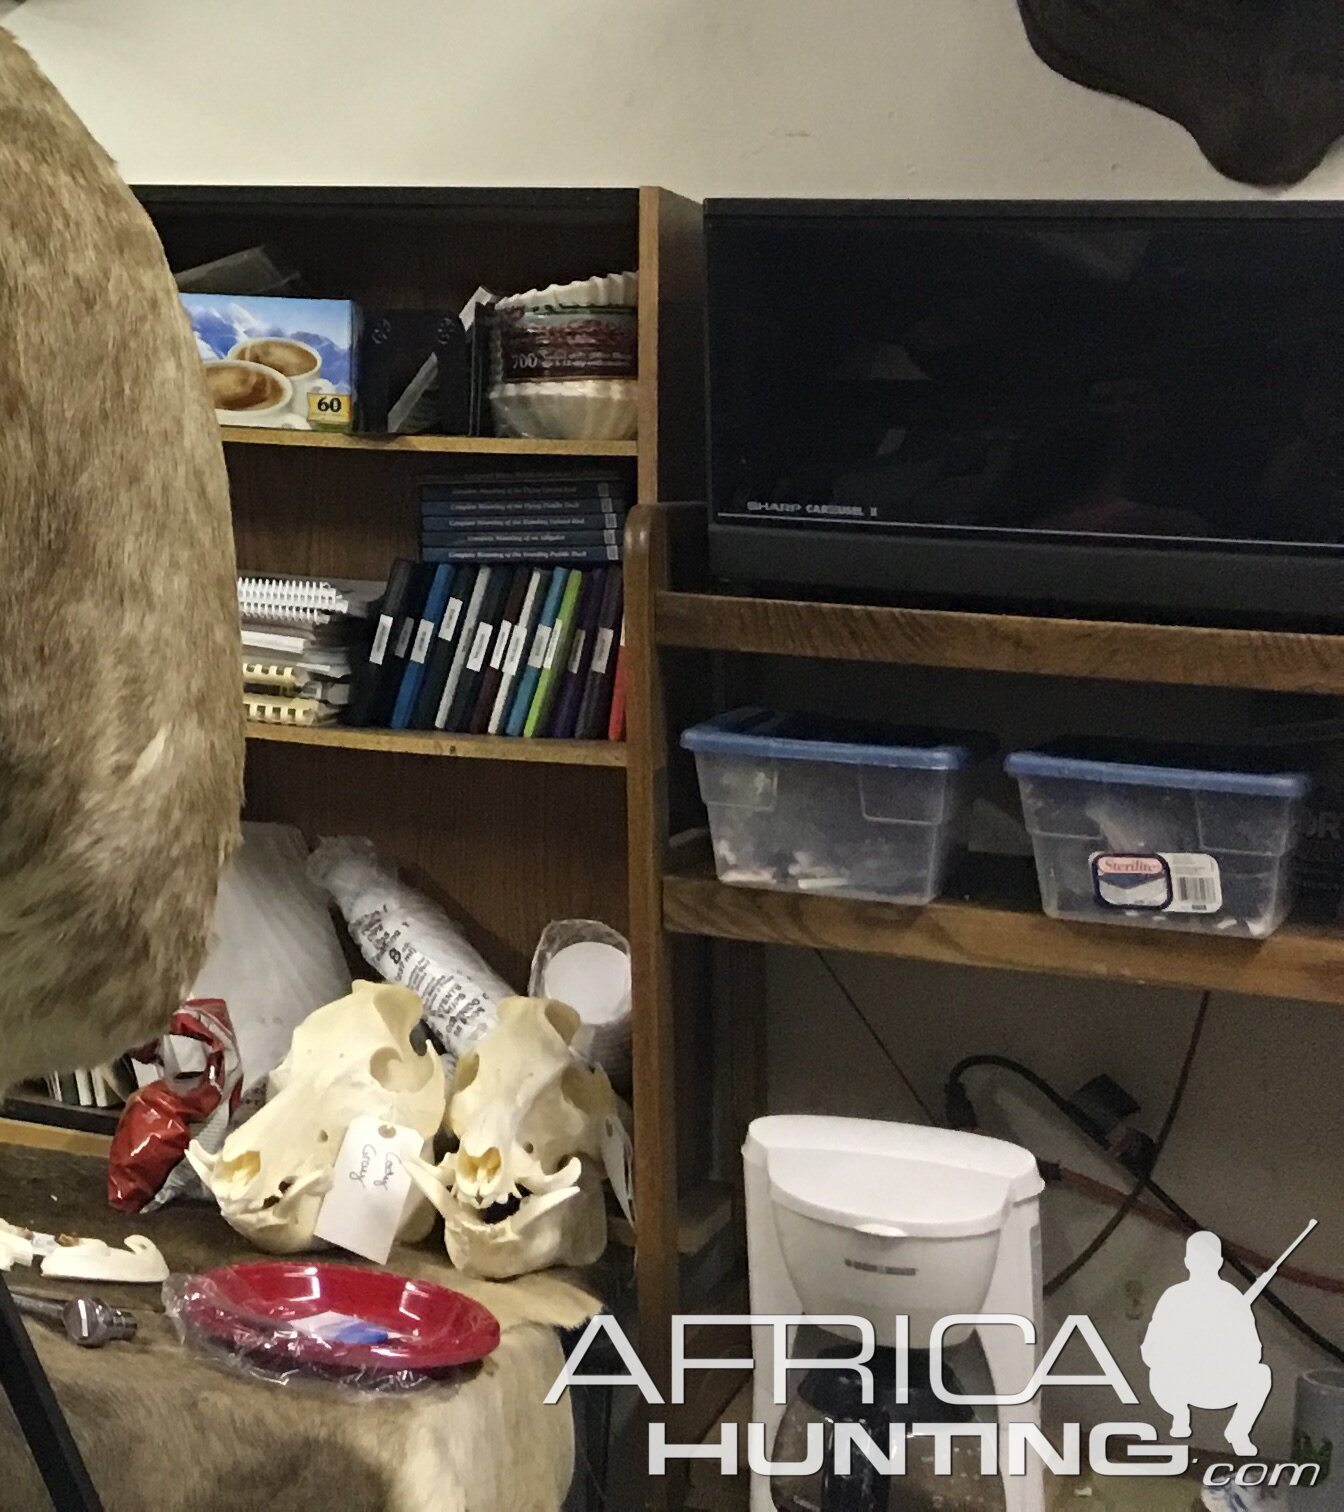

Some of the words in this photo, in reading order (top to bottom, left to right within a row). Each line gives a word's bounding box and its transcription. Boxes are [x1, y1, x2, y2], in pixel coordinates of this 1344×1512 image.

[317, 396, 342, 412] 60
[746, 501, 802, 513] SHARP
[1104, 859, 1155, 873] Sterilite
[389, 947, 402, 965] 8
